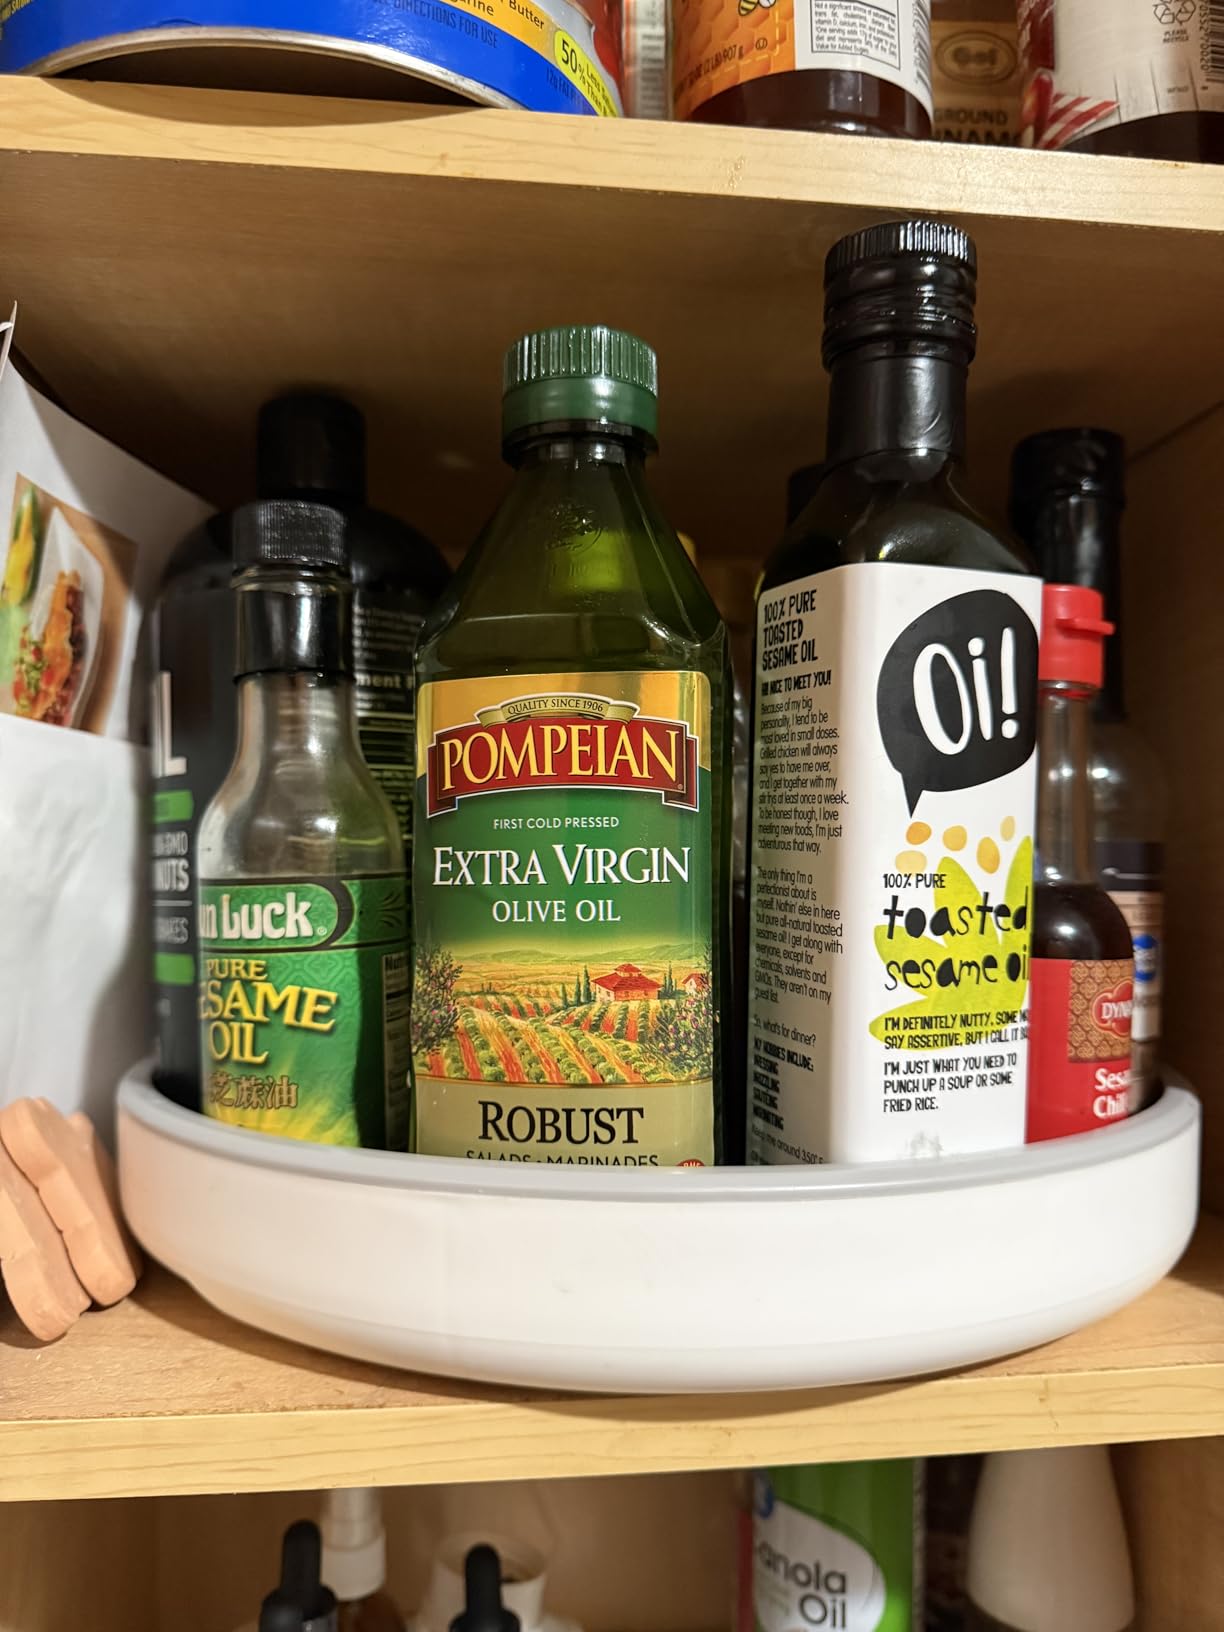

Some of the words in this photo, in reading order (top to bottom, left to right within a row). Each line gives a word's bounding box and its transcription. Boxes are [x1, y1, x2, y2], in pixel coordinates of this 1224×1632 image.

[509, 0, 544, 29] Butter
[459, 16, 478, 38] FOR
[481, 26, 498, 48] USE
[765, 597, 786, 624] 100%
[789, 589, 817, 616] PURE
[764, 619, 803, 648] TOASTED
[763, 644, 799, 671] SESAME
[801, 639, 818, 662] OIL
[784, 677, 791, 692] TO
[794, 674, 811, 690] MEET
[814, 670, 831, 688] YOU!
[912, 626, 1019, 755] Oi!
[508, 699, 549, 715] QUALITY
[551, 698, 581, 708] SINCE
[582, 700, 604, 712] 1906
[785, 698, 790, 711] of
[792, 699, 801, 712] my
[802, 696, 812, 711] big
[796, 711, 809, 725] tend
[811, 712, 817, 724] to
[819, 708, 828, 723] be
[774, 729, 789, 743] loved
[791, 730, 796, 741] in
[797, 727, 814, 741] small
[816, 726, 839, 739] doses.
[441, 724, 679, 791] POMPEIAN
[778, 745, 799, 758] chicken
[801, 743, 811, 756] will
[812, 742, 838, 758] always
[780, 763, 785, 773] to
[787, 761, 801, 773] have
[802, 762, 813, 772] me
[815, 761, 831, 773] over,
[773, 778, 782, 791] get
[783, 776, 808, 791] together
[810, 775, 823, 788] with
[825, 777, 837, 791] my
[785, 791, 798, 804] least
[800, 794, 816, 804] once
[817, 794, 822, 804] a
[824, 790, 849, 804] week.
[493, 818, 523, 829] FIRST
[527, 818, 561, 829] COLD
[565, 817, 619, 828] PRESSED
[773, 807, 792, 819] honest
[794, 807, 817, 824] though,
[823, 807, 838, 821] love
[781, 825, 793, 835] new
[795, 822, 814, 838] foods,
[815, 824, 826, 837] I'm
[827, 824, 842, 840] just
[793, 838, 805, 852] that
[806, 842, 821, 856] way.
[432, 847, 548, 885] EXTRA
[552, 844, 691, 885] VIRGIN
[768, 867, 779, 882] only
[780, 868, 795, 885] thing
[797, 870, 806, 883] I'm
[808, 874, 812, 884] a
[883, 873, 913, 888] 100%
[915, 873, 946, 888] PURE
[791, 885, 809, 900] about
[811, 888, 816, 900] is
[221, 892, 314, 940] Luck
[492, 900, 566, 922] OLIVE
[575, 900, 621, 922] OIL
[798, 902, 812, 915] else
[813, 904, 819, 917] in
[821, 904, 840, 920] here
[883, 886, 1029, 940] toasted
[766, 914, 778, 926] pure
[813, 922, 843, 937] toasted
[792, 935, 802, 948] get
[803, 935, 822, 953] along
[824, 939, 843, 953] with
[783, 948, 803, 965] except
[805, 951, 814, 965] for
[884, 955, 997, 990] sesame
[1006, 944, 1028, 982] oi
[206, 958, 268, 980] PURE
[785, 963, 810, 980] solvents
[812, 970, 826, 984] and
[774, 974, 788, 994] They
[789, 982, 807, 995] aren't
[809, 987, 818, 999] on
[820, 990, 831, 1005] my
[884, 1017, 900, 1031] I'M
[903, 1014, 957, 1030] DEFINITELY
[960, 1012, 994, 1027] NUTTY.
[996, 1011, 1018, 1023] SOME
[208, 1020, 269, 1064] OIL
[782, 1022, 790, 1038] for
[791, 1028, 816, 1047] dinner?
[885, 1035, 903, 1049] SAY
[908, 1032, 963, 1048] ASSERTIVE,
[965, 1031, 983, 1045] BUT
[985, 1031, 989, 1043] I
[991, 1030, 1008, 1043] CALL
[1011, 1028, 1018, 1041] IT
[884, 1062, 899, 1075] I'M
[903, 1059, 929, 1074] JUST
[932, 1058, 959, 1073] WHAT
[963, 1056, 981, 1071] YOU
[983, 1055, 1005, 1069] NEED
[1006, 1053, 1017, 1065] TO
[884, 1078, 919, 1094] PUNCH
[922, 1078, 936, 1092] UP
[939, 1077, 944, 1090] A
[948, 1075, 973, 1089] SOUP
[976, 1073, 987, 1086] OR
[990, 1071, 1013, 1085] SOME
[884, 1098, 912, 1112] FRIED
[915, 1097, 938, 1111] RICE.
[478, 1100, 644, 1145] ROBUST
[758, 1539, 847, 1595] anola
[799, 1594, 847, 1630] Oil
